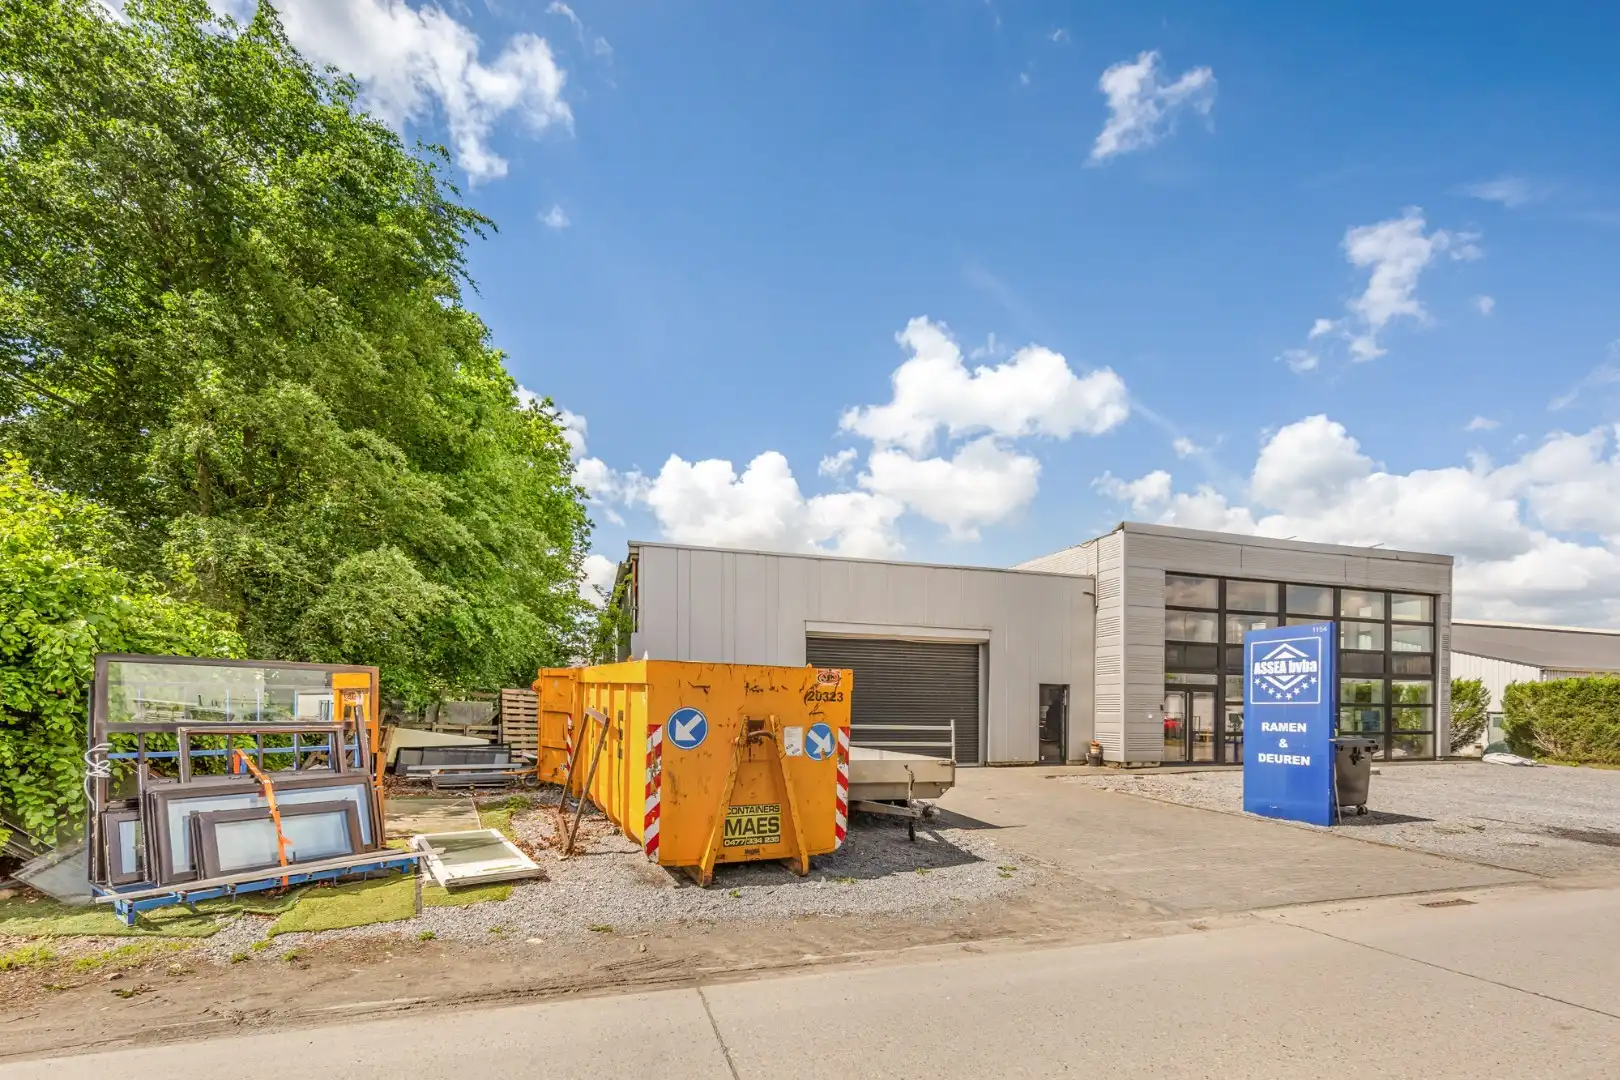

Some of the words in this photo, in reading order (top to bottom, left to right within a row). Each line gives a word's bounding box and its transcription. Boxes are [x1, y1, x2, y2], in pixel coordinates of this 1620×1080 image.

[1253, 661, 1287, 675] ASSEA
[1288, 659, 1318, 674] bvba
[807, 691, 844, 702] 20323
[1261, 721, 1307, 733] RAMEN
[1278, 738, 1288, 748] &
[1257, 752, 1311, 766] DEUREN
[724, 816, 780, 837] MAES
[724, 838, 746, 846] 0477
